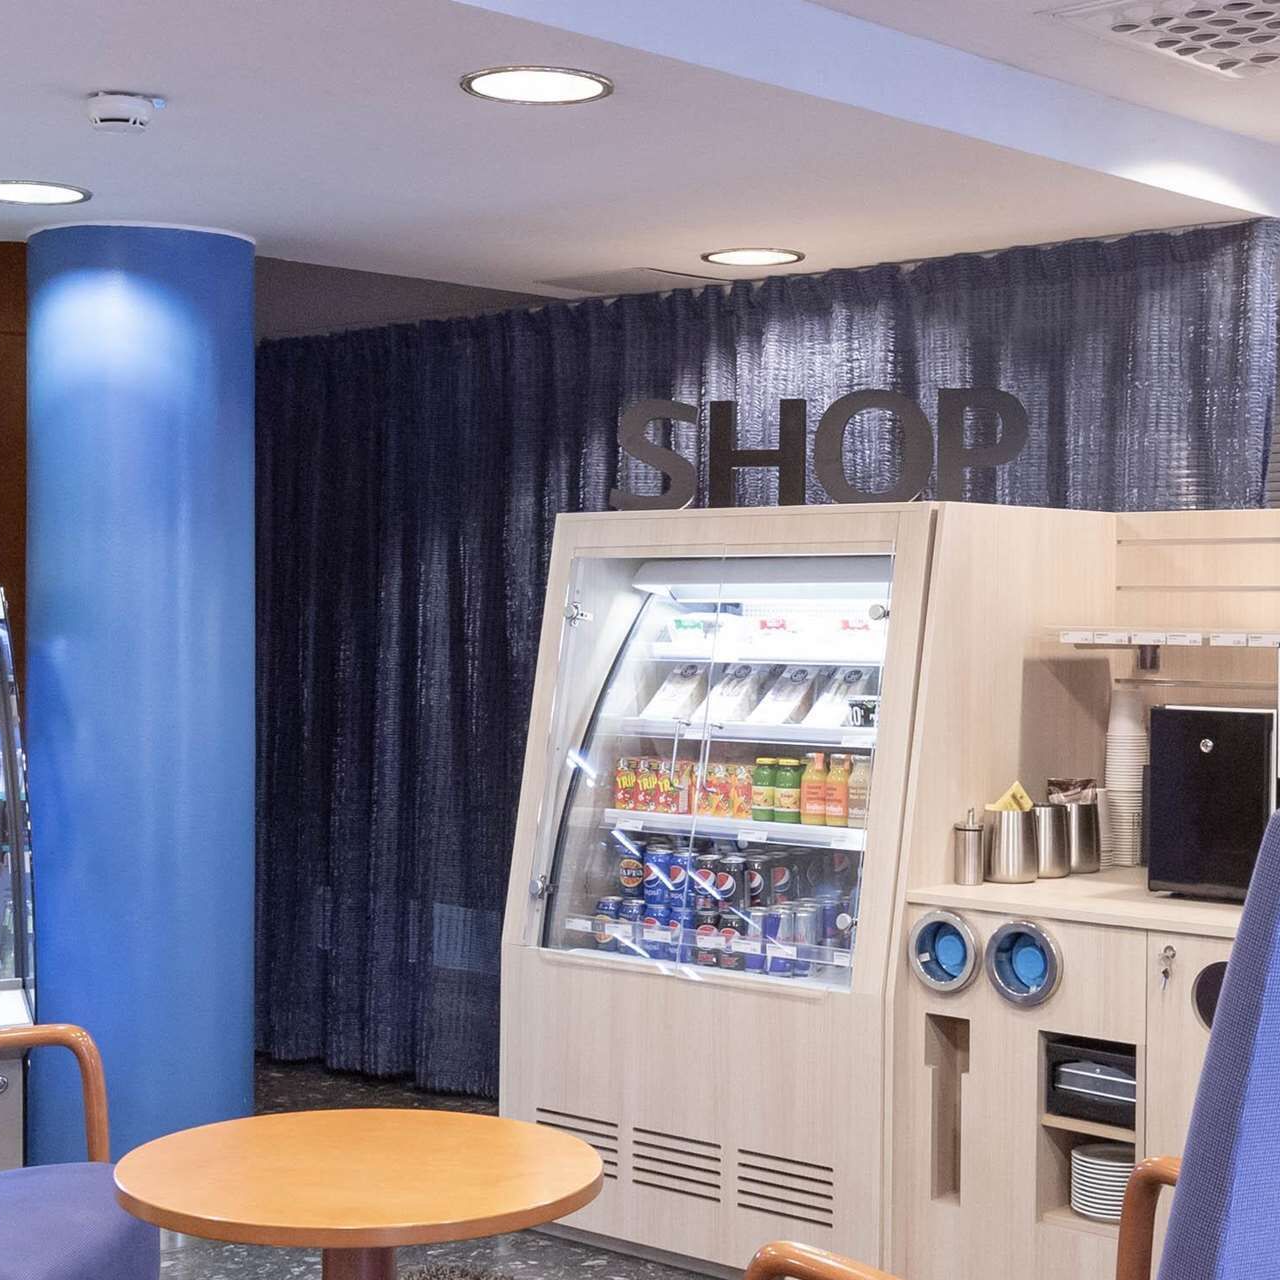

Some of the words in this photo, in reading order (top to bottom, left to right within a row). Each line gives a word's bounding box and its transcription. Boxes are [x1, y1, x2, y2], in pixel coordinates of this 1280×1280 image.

[609, 388, 1027, 510] SHOP
[616, 773, 636, 789] TRIP
[637, 775, 658, 790] TRIP
[658, 777, 679, 792] TRP
